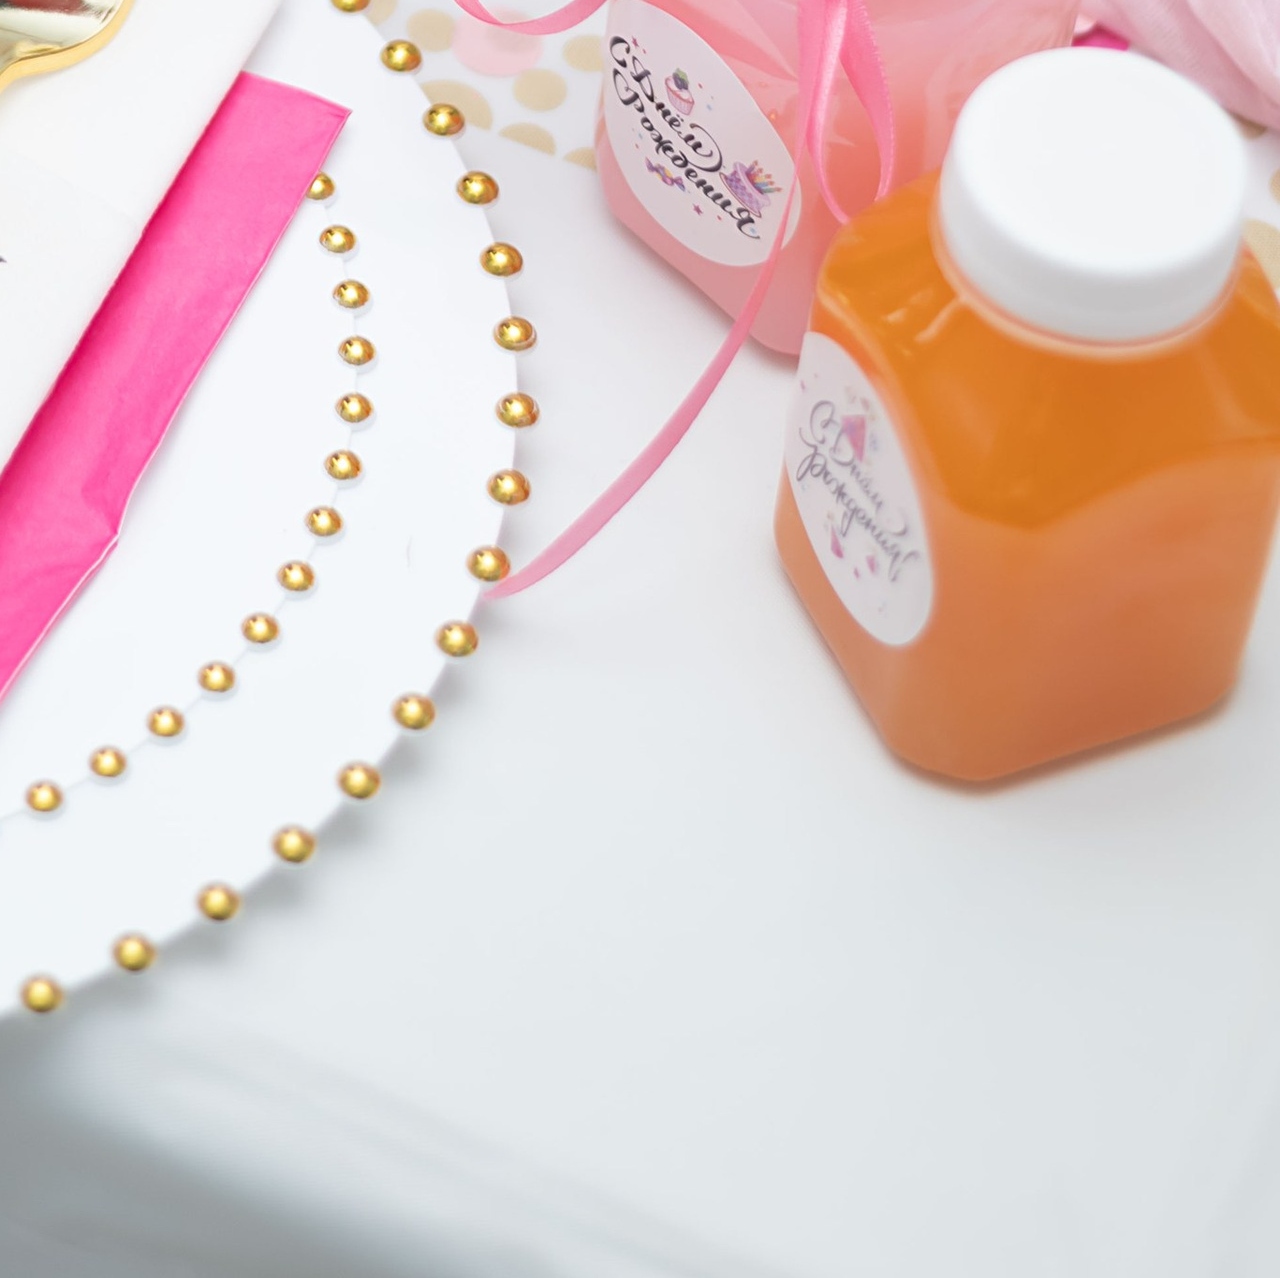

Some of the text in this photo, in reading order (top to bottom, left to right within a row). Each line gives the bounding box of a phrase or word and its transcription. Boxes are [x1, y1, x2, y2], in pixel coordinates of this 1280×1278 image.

[609, 36, 714, 158] С Днём
[613, 68, 761, 240] Рождения
